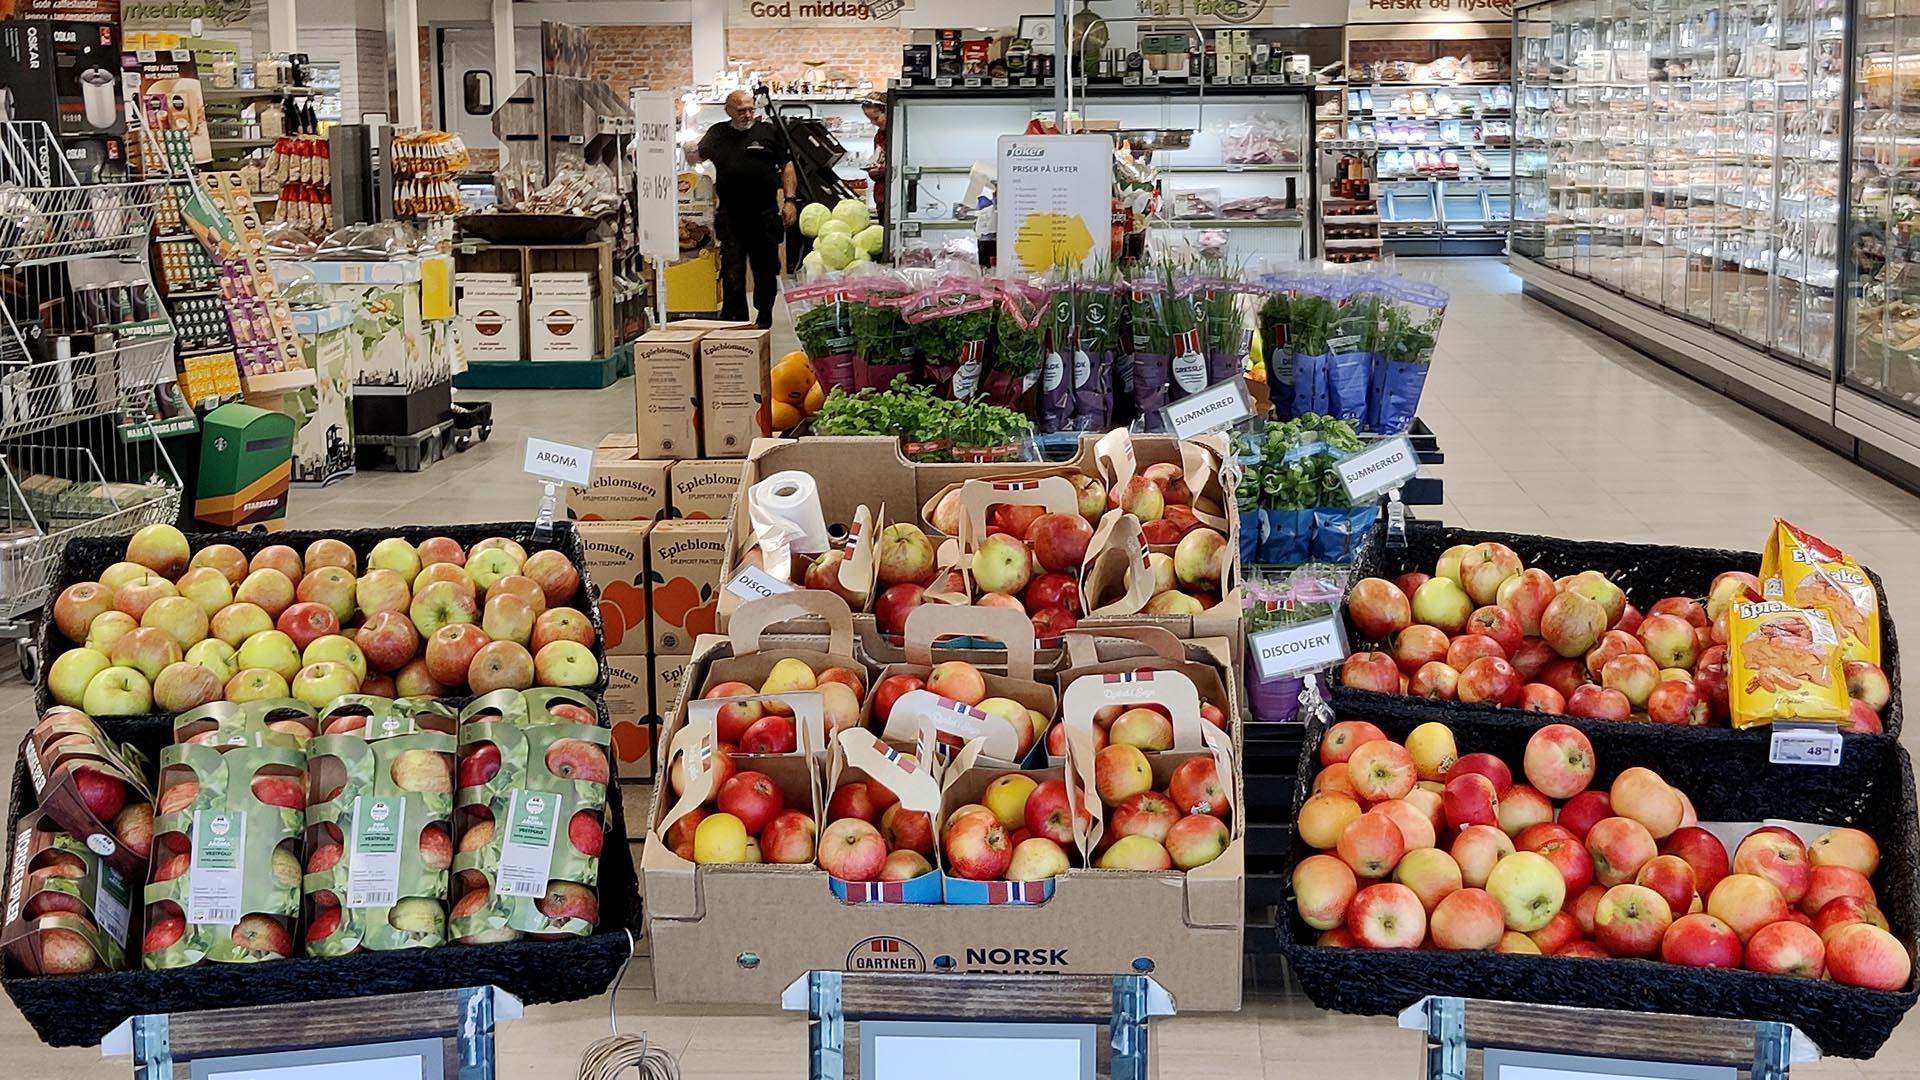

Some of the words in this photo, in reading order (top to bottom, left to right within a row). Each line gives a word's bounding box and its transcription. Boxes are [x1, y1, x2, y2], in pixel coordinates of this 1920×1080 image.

[751, 1, 790, 18] God
[799, 0, 869, 20] middag
[1430, 0, 1449, 11] og
[1458, 0, 1512, 11] nystek
[54, 32, 76, 42] OSKAR
[27, 27, 40, 69] OSKAR
[66, 149, 87, 160] OSKAR
[1012, 165, 1039, 173] PRISER
[1041, 164, 1051, 173] PÅ
[1053, 165, 1078, 173] URTER
[640, 347, 691, 359] Epleblomsten
[703, 343, 754, 356] Epleblomsten
[1175, 396, 1234, 426] SUMMERRED
[536, 451, 577, 469] AROMA
[1346, 452, 1404, 484] SUMMERRED
[572, 476, 657, 497] Eeblomsten
[676, 473, 740, 495] Eplebloms
[243, 498, 278, 511] STARBUCKS
[584, 539, 635, 561] lomsten
[657, 538, 726, 560] Eplebloms
[739, 575, 776, 597] DISCO
[1262, 633, 1331, 659] DISCOVERY
[11, 827, 32, 886] NORSKE
[5, 879, 23, 927] EPLER
[856, 957, 916, 969] GARTNER
[966, 948, 1069, 966] NORSK
